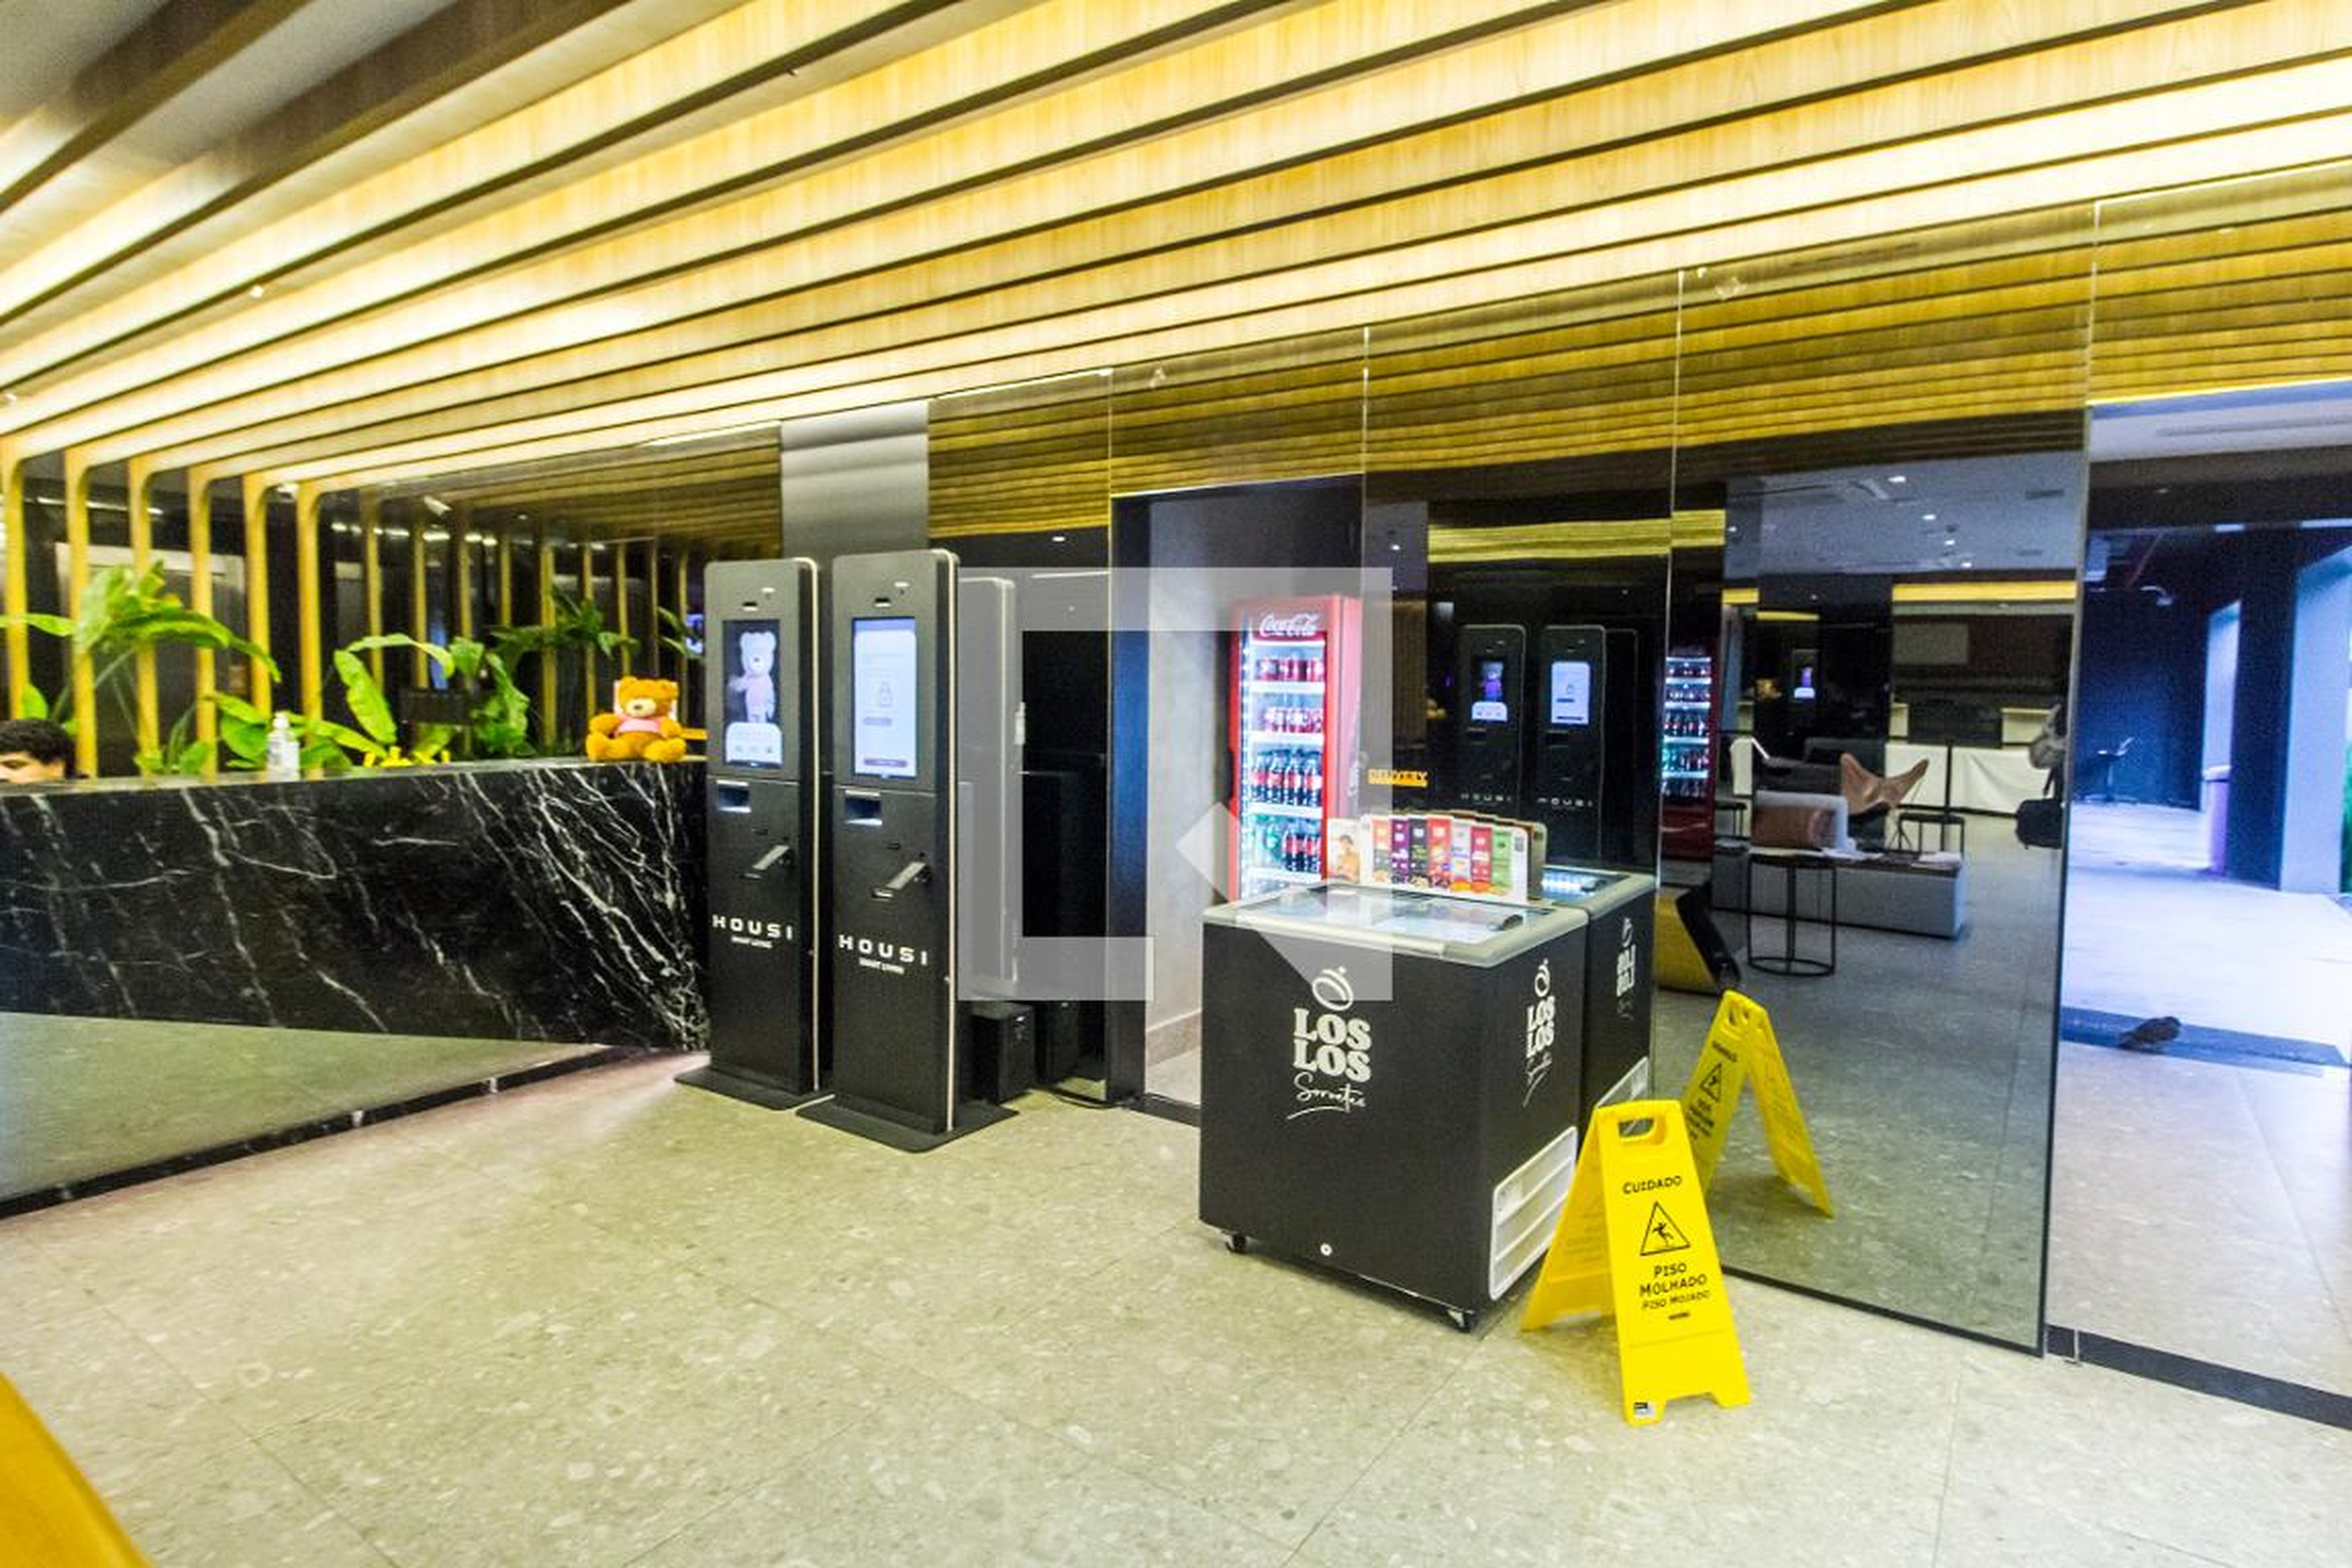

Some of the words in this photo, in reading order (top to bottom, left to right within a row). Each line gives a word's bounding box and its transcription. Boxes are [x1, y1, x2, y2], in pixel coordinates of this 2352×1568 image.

[712, 914, 793, 940] HOUSI
[839, 934, 928, 966] HOUSI
[1293, 1008, 1372, 1051] LOS
[1292, 1038, 1372, 1082] LOS
[1623, 1175, 1683, 1194] CUIDADO
[1654, 1262, 1687, 1278] PISO
[1639, 1273, 1708, 1297] MOLHADO
